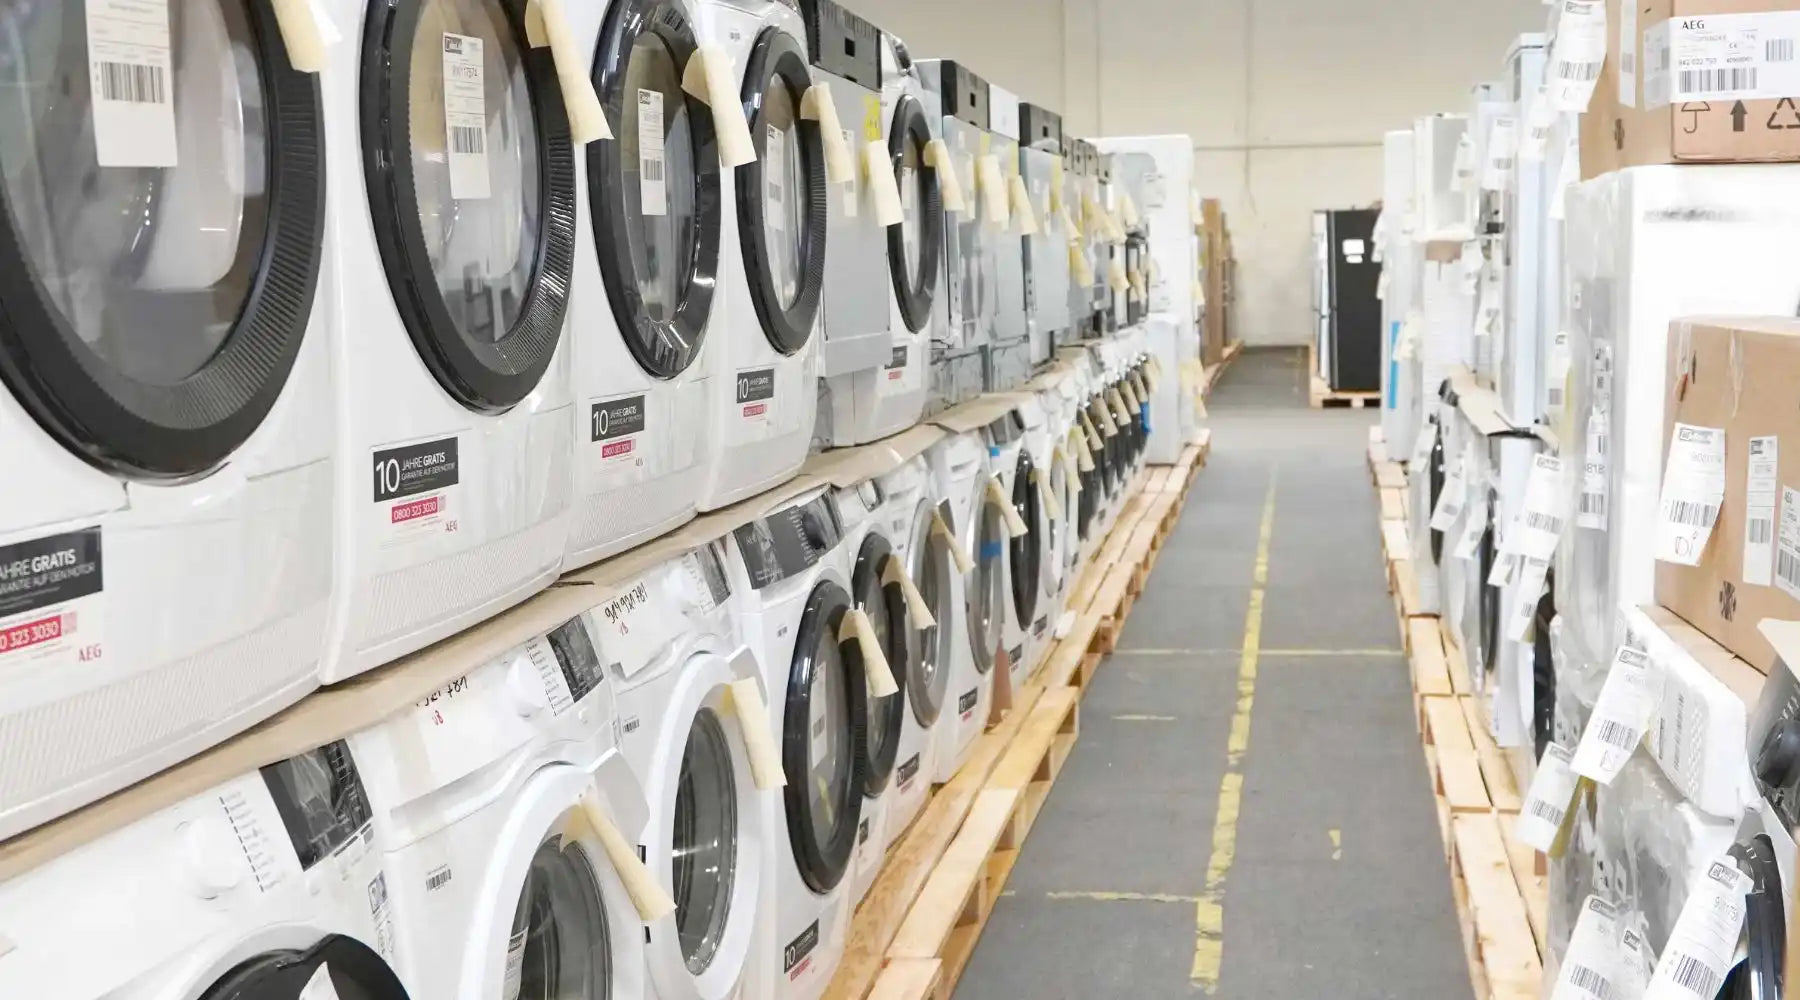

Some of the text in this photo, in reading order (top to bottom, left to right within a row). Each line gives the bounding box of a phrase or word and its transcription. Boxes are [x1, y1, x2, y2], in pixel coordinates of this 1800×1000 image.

[1682, 20, 1705, 30] AEG
[738, 378, 749, 399] 10
[593, 409, 608, 436] 10
[402, 452, 446, 471] JAHRE GRATIS
[376, 458, 400, 494] 10
[393, 507, 411, 521] 0800
[422, 502, 437, 515] 3030
[32, 549, 77, 573] GRATIS
[10, 628, 30, 648] 323
[31, 620, 59, 643] 3030
[78, 643, 102, 662] AEG
[785, 945, 796, 969] 10
